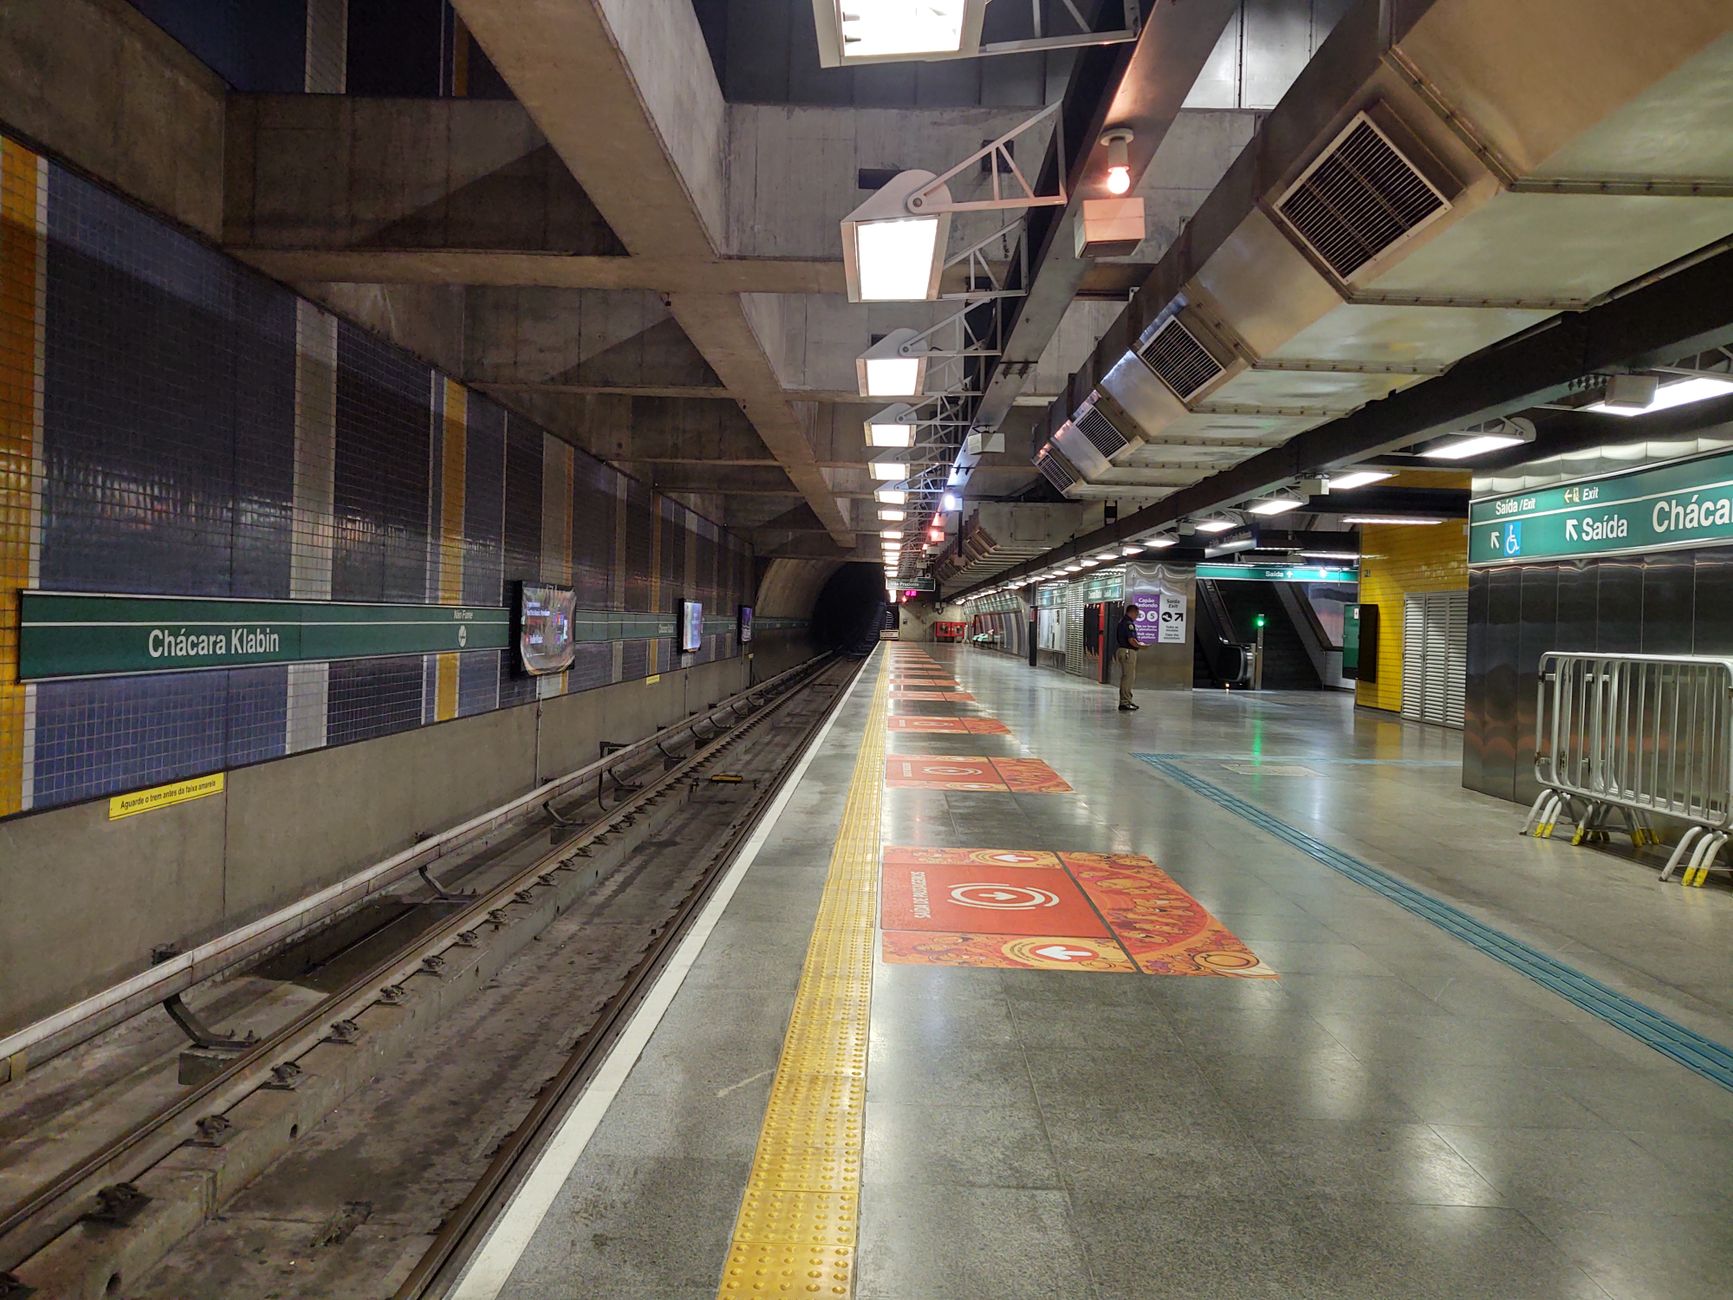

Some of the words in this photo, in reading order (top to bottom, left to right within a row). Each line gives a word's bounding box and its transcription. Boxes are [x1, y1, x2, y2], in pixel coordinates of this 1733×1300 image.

[1495, 499, 1518, 516] Saída
[1582, 487, 1599, 501] Exit
[1652, 494, 1733, 533] Cháca
[1582, 514, 1628, 541] Saída
[1265, 570, 1284, 578] Saída
[148, 628, 226, 658] Chácara
[231, 628, 279, 654] Klabin
[120, 798, 145, 810] Aguarde
[150, 793, 162, 802] trem
[162, 790, 177, 799] antes
[177, 787, 185, 795] da
[185, 784, 198, 793] faixa
[198, 779, 216, 790] amarela
